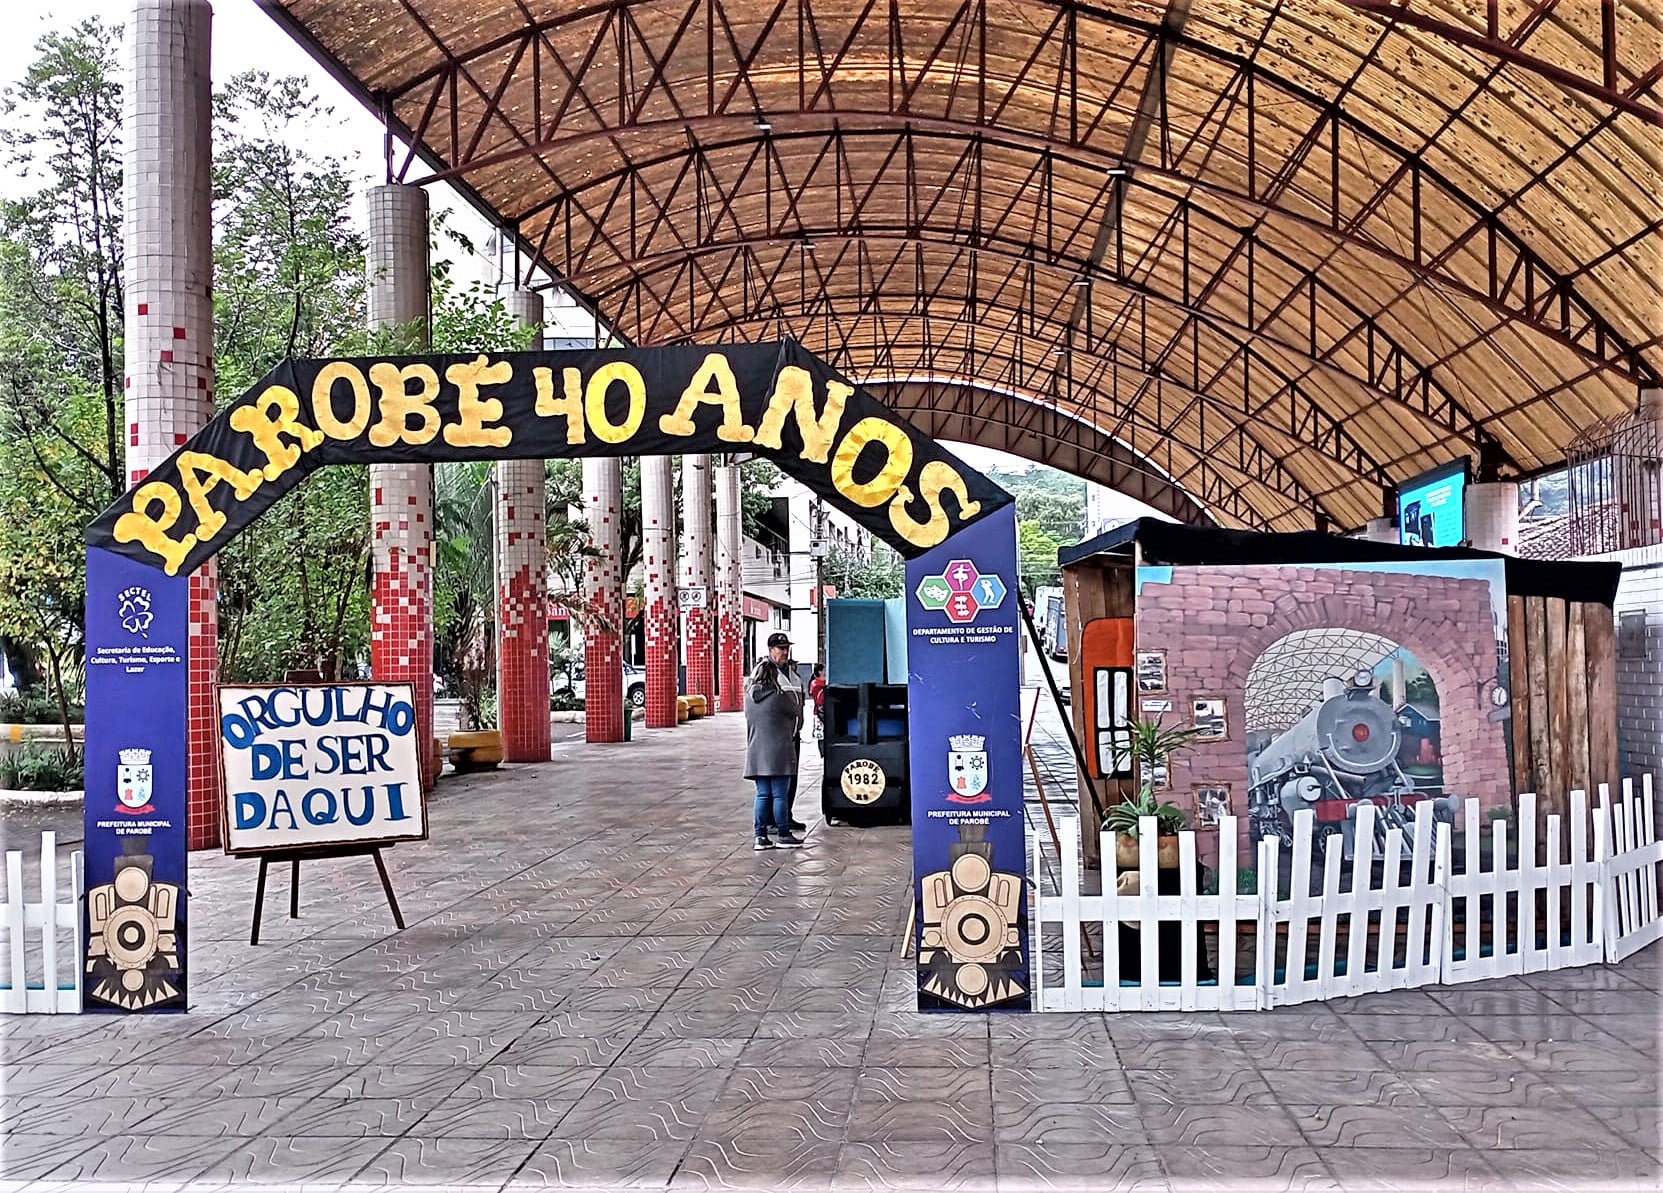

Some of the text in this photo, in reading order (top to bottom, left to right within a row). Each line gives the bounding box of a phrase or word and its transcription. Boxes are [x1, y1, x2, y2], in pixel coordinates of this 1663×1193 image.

[533, 361, 647, 445] 40
[659, 353, 982, 549] ANOS
[118, 587, 152, 601] SECTEL
[912, 626, 1013, 636] DEPARTAMENTO DE GESTÃO DE
[930, 636, 960, 644] CULTURA
[966, 635, 997, 643] TURISMO
[97, 647, 131, 655] Secretaria
[142, 646, 176, 655] Educação,
[90, 656, 118, 664] Cultura,
[119, 656, 148, 664] Turismo,
[149, 656, 174, 664] Esporte
[221, 686, 415, 750] ORGULHO
[250, 734, 395, 781] DE SER
[848, 773, 879, 785] 1982
[232, 782, 413, 830] DAQUI
[928, 810, 1011, 818] PREFEITURA MUNICIPAL
[97, 820, 172, 828] PREFEITURA MUNICIPAL
